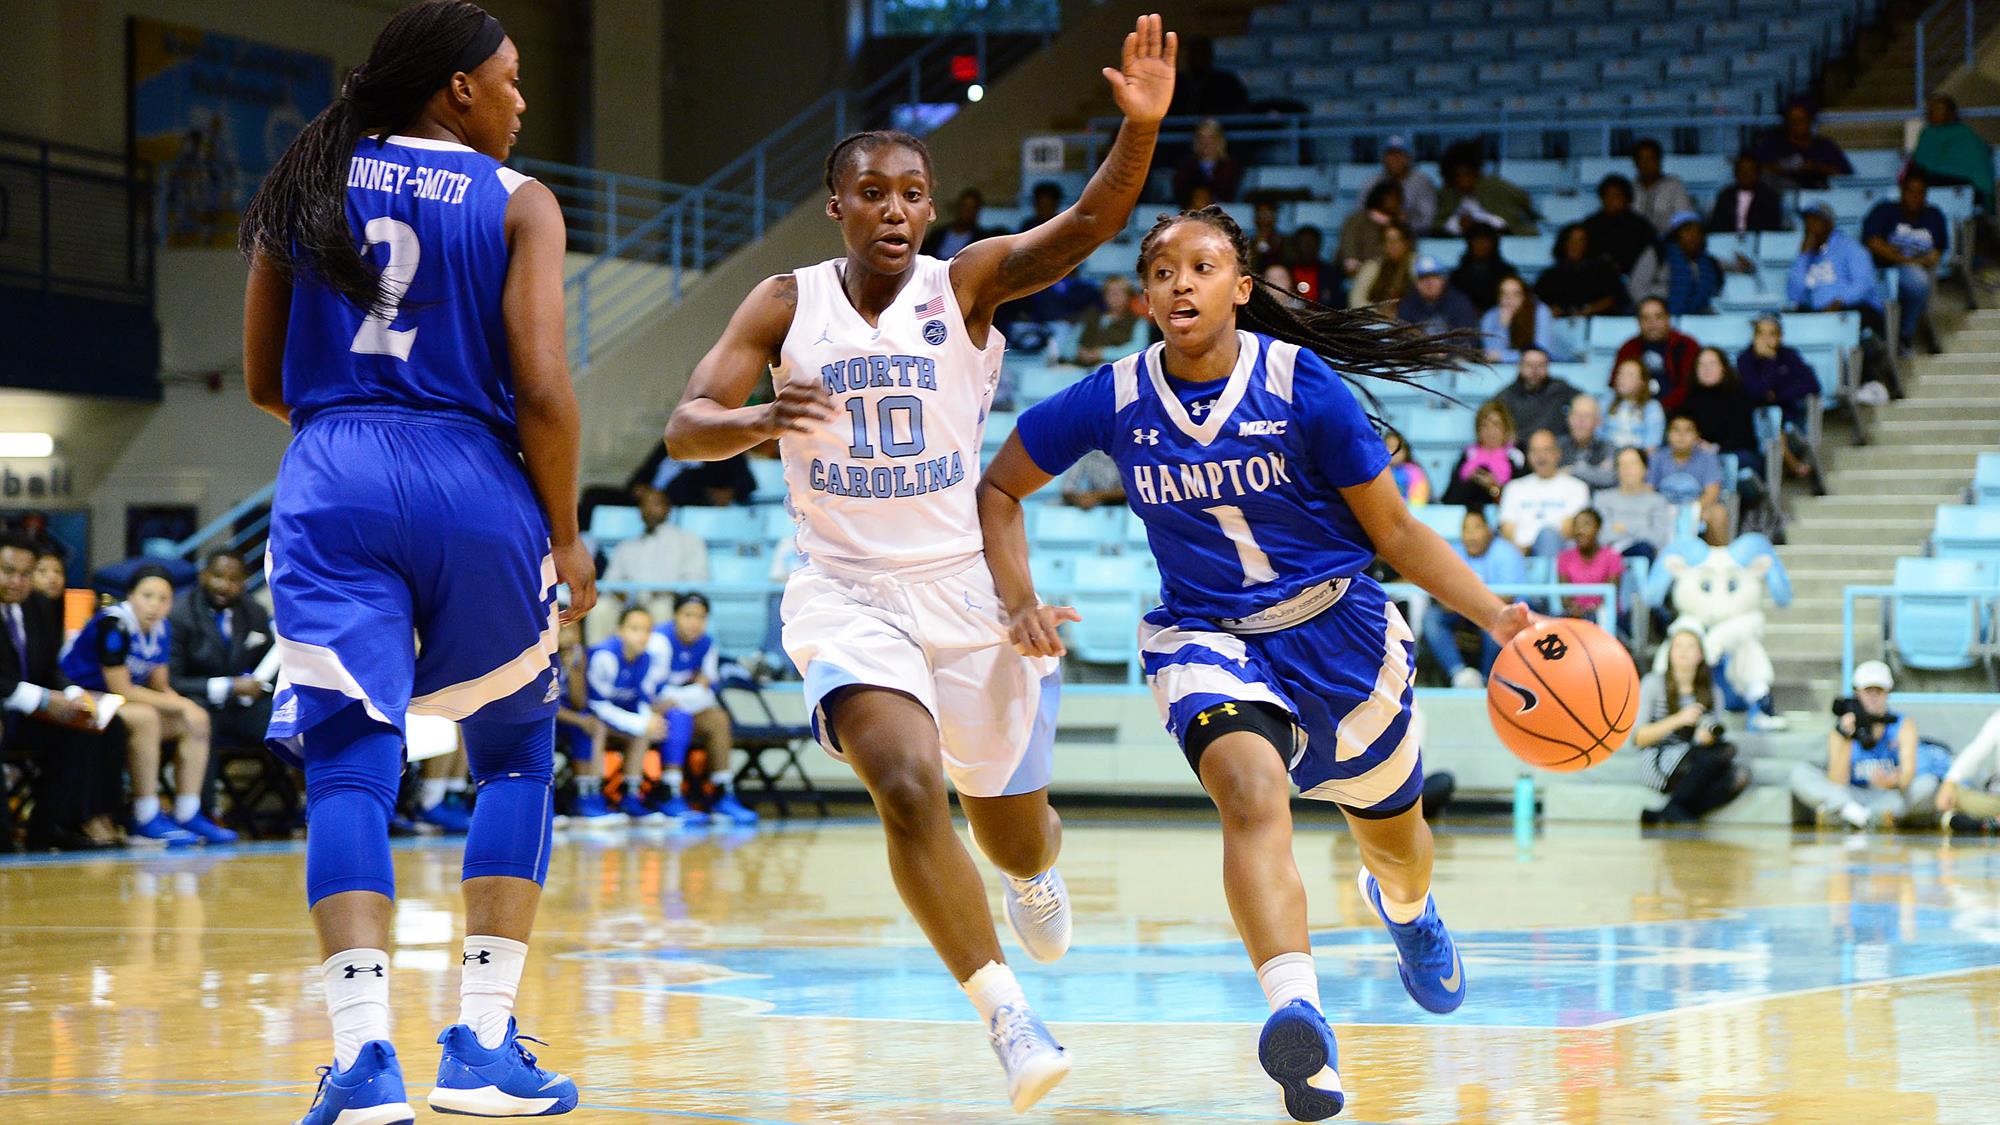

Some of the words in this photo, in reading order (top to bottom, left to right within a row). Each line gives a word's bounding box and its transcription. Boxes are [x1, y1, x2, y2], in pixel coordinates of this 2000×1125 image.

[349, 216, 421, 362] 2
[821, 355, 937, 396] NORTH
[845, 395, 926, 459] 10
[1238, 420, 1288, 437] MEAC
[810, 451, 965, 498] CAROLINA
[1133, 451, 1292, 504] HAMPTON
[1201, 504, 1280, 587] 1
